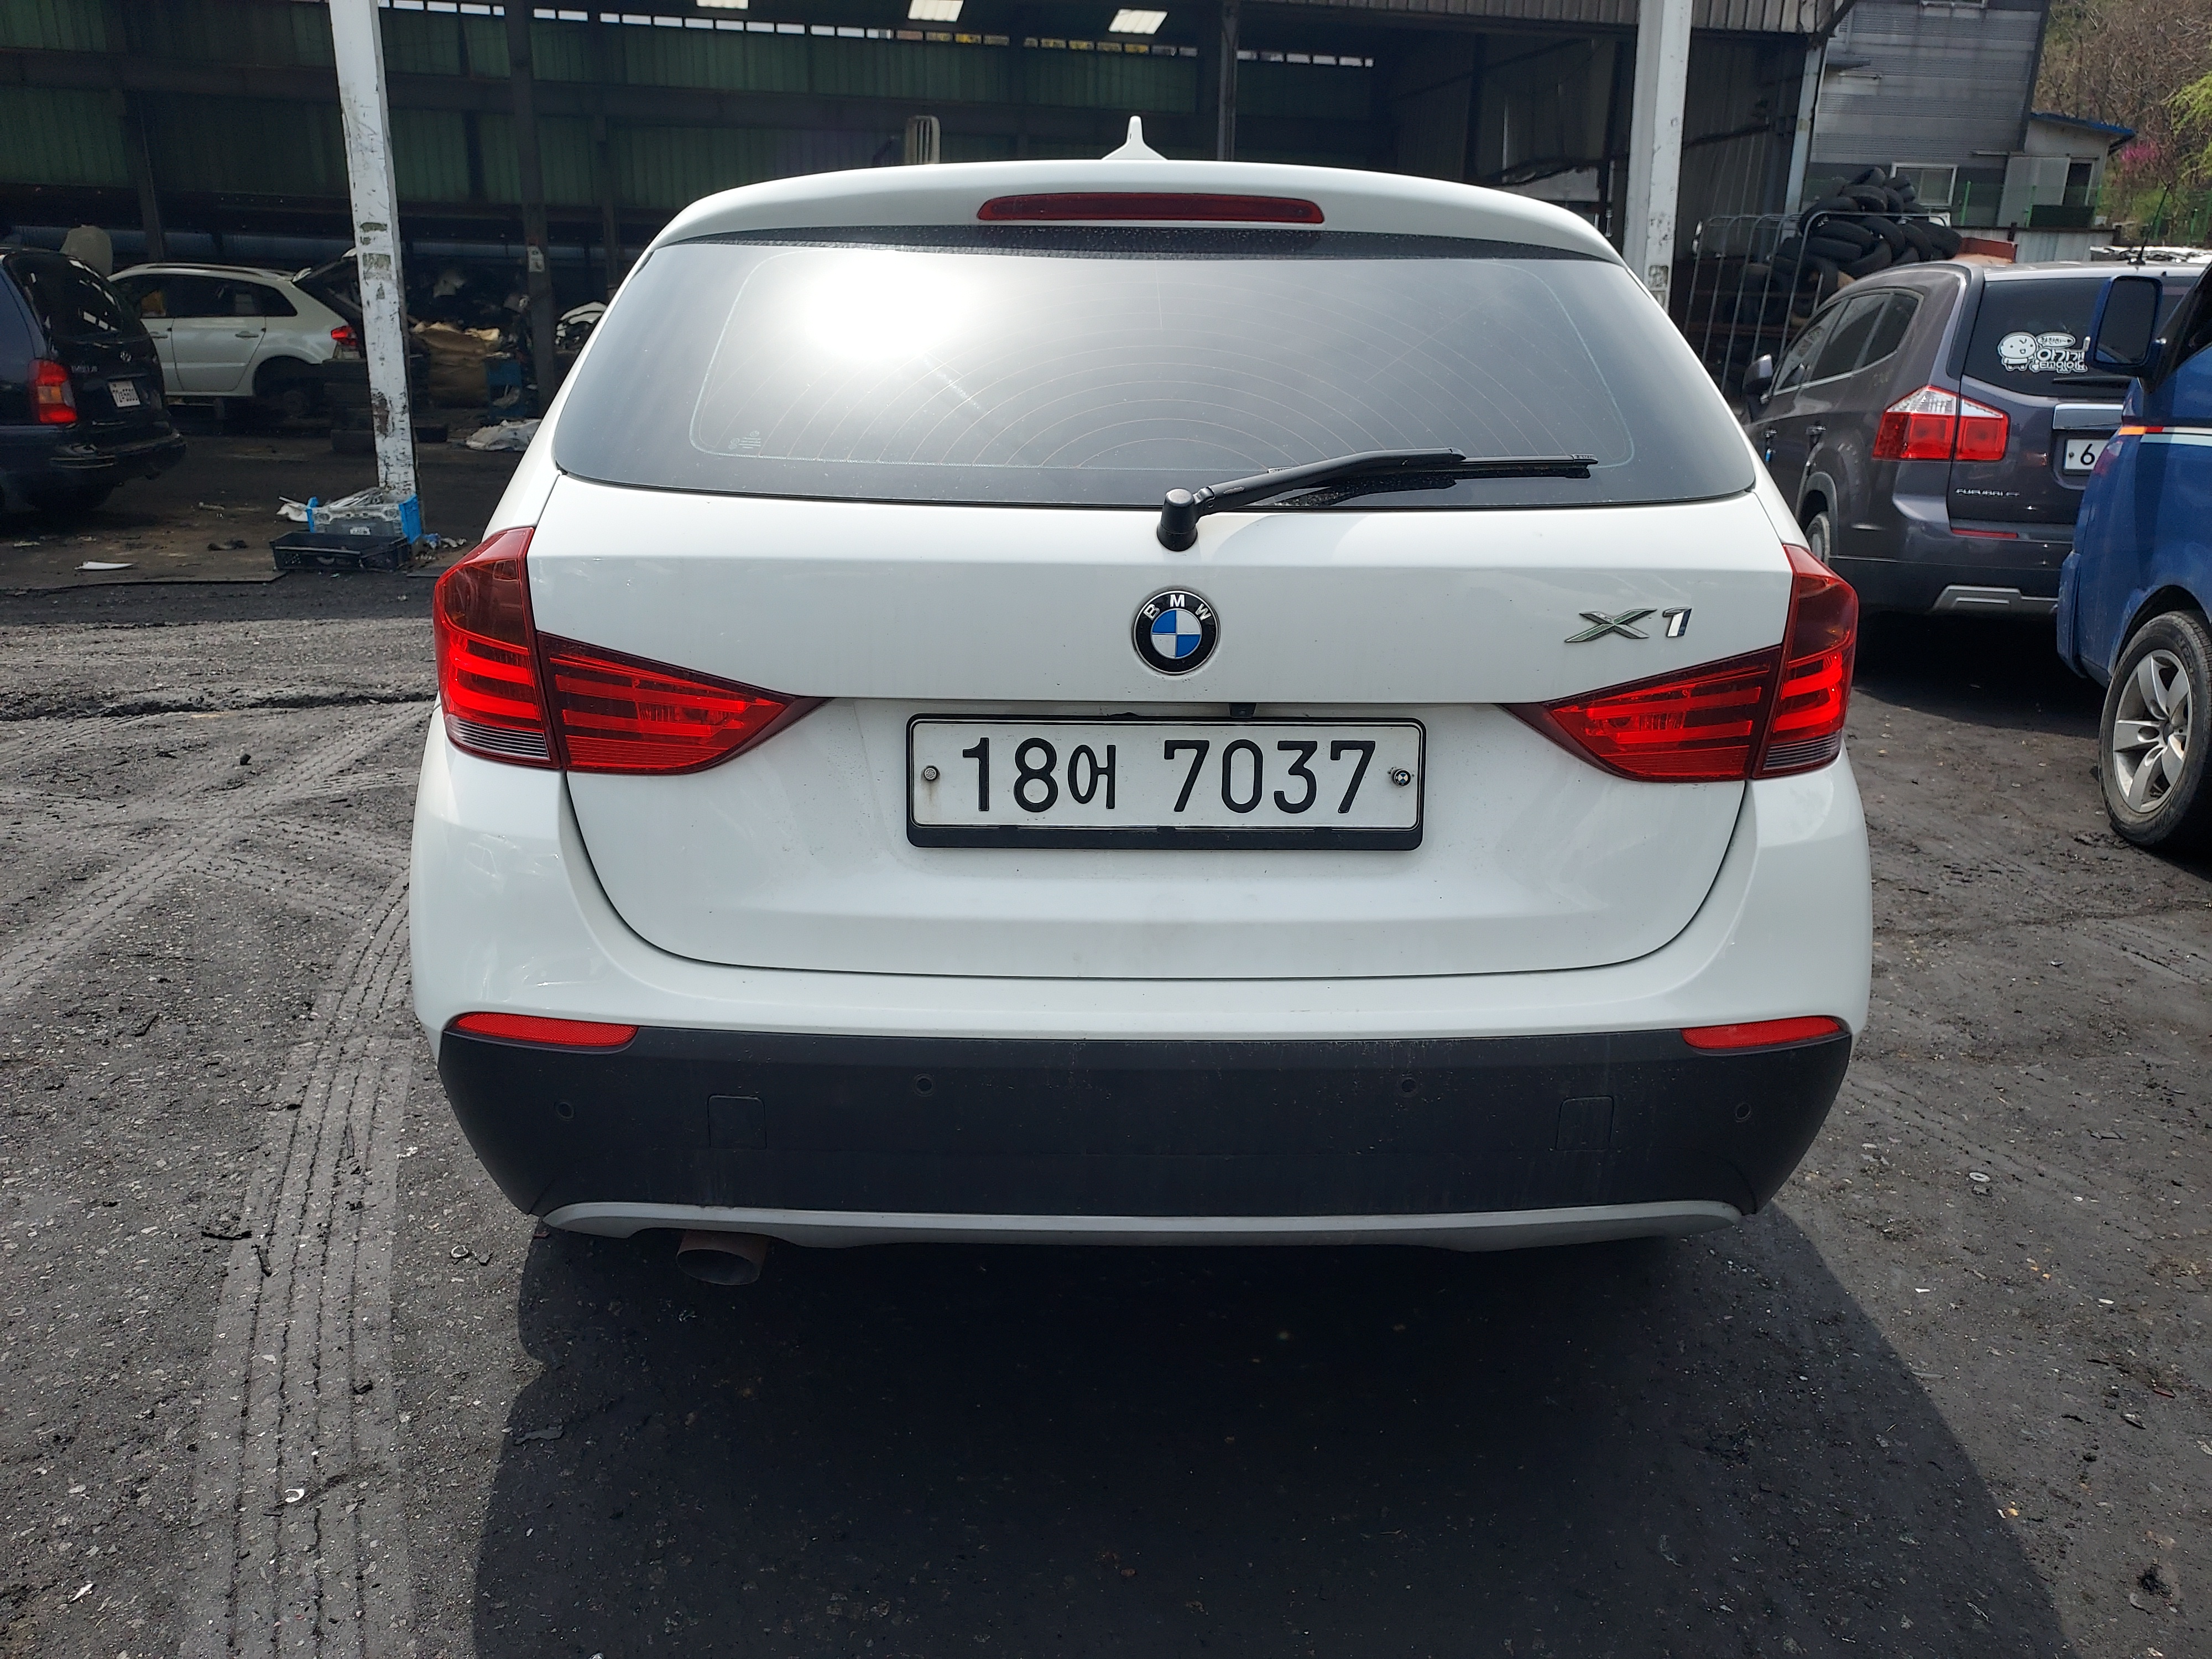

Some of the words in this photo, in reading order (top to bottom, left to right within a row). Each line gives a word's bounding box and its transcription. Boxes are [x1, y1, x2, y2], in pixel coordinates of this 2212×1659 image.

[1143, 594, 1212, 620] BMW
[1564, 607, 1692, 643] X1
[962, 737, 1116, 812] 18어
[1164, 739, 1376, 813] 7037
